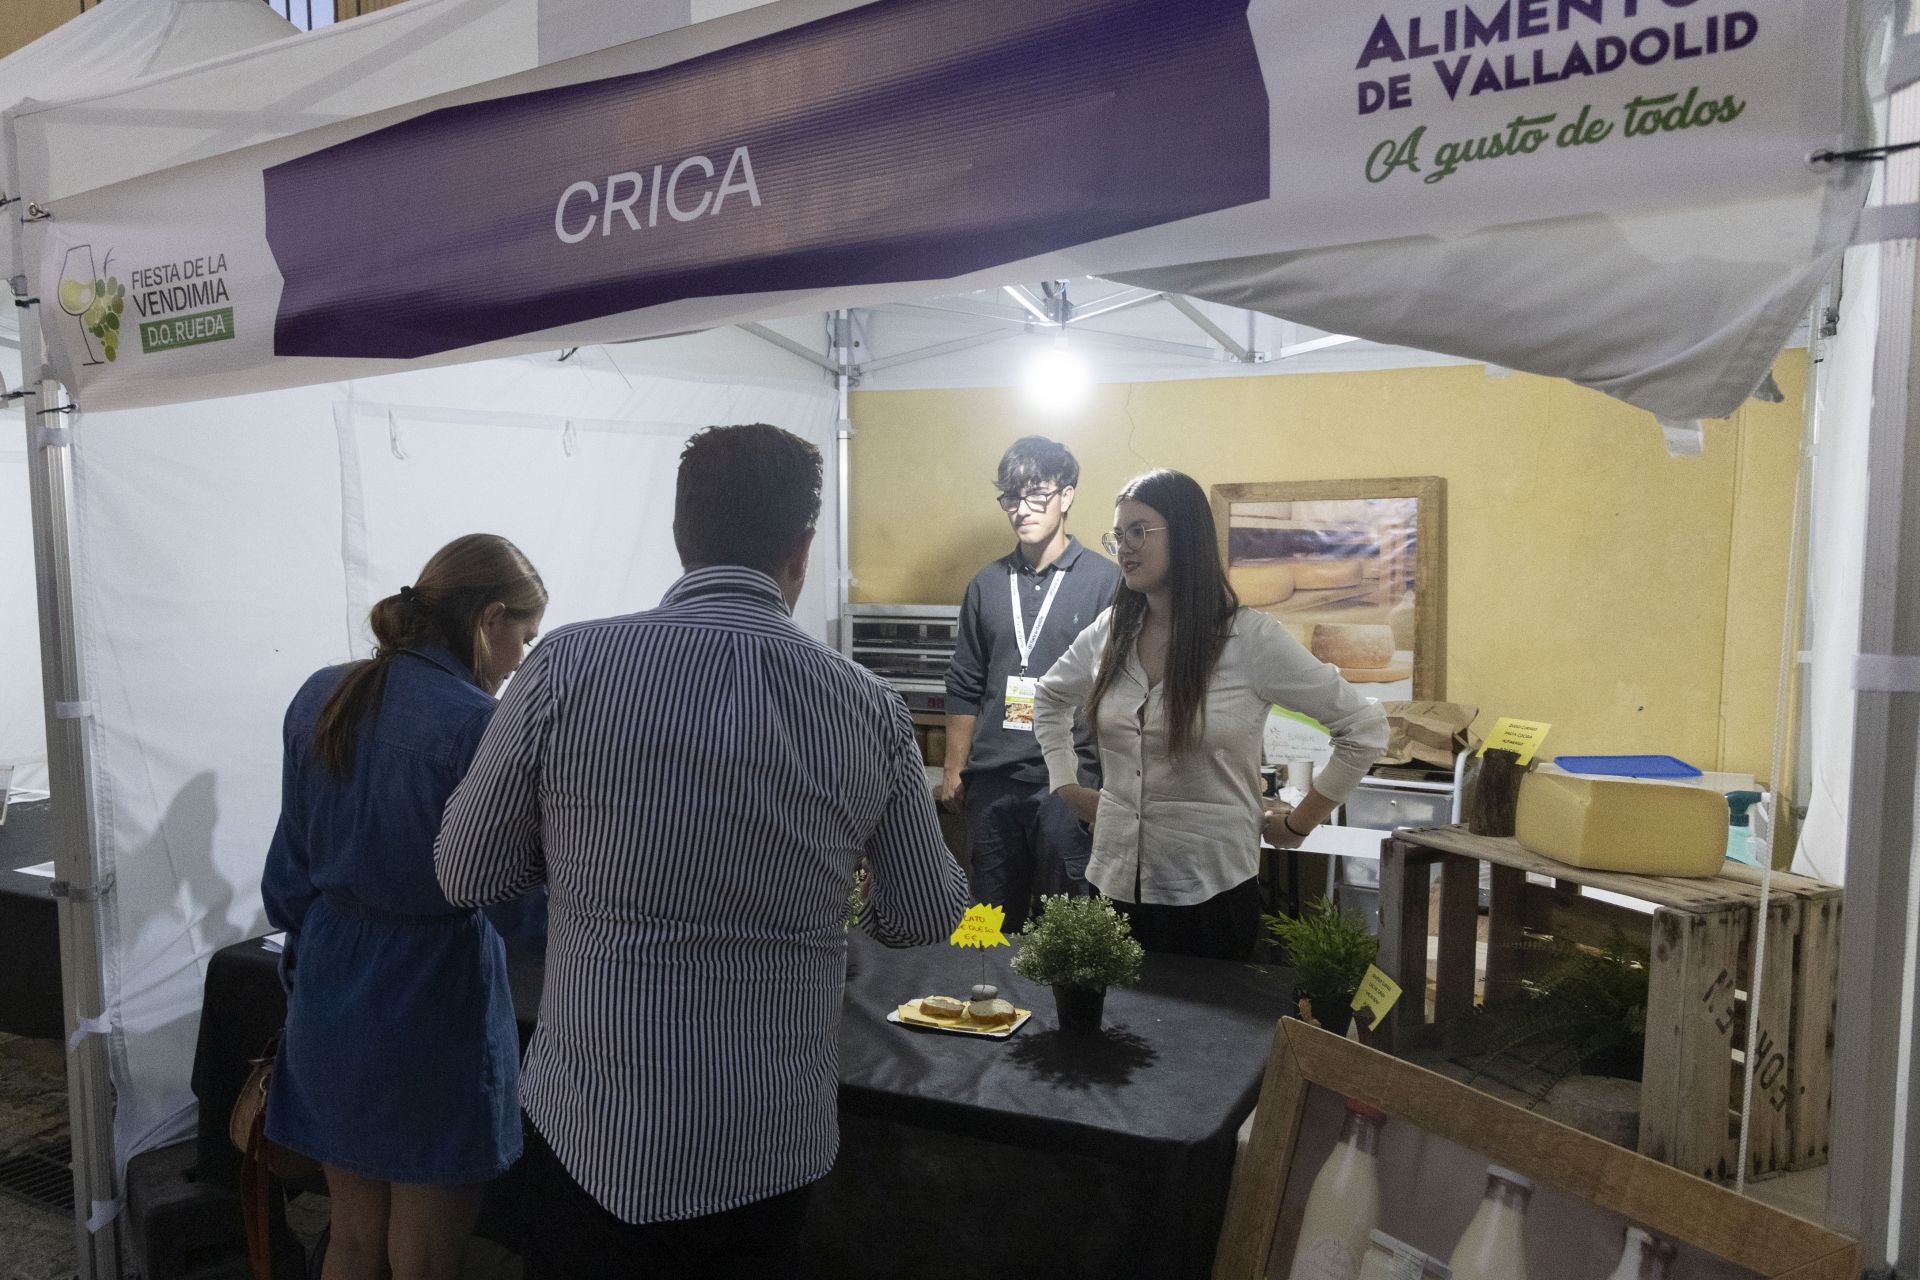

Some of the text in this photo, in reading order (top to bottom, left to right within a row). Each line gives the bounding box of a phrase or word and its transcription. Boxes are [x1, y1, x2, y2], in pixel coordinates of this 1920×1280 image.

[1355, 0, 1698, 70] ALIMEN
[1358, 11, 1758, 115] DE VALLADOLID
[1365, 86, 1746, 184] A gusto de todos
[555, 146, 762, 244] CRICA
[132, 253, 228, 290] FIESTA DE LA
[132, 278, 229, 317] VENDIMIA
[147, 314, 226, 347] D.O. RUEDA
